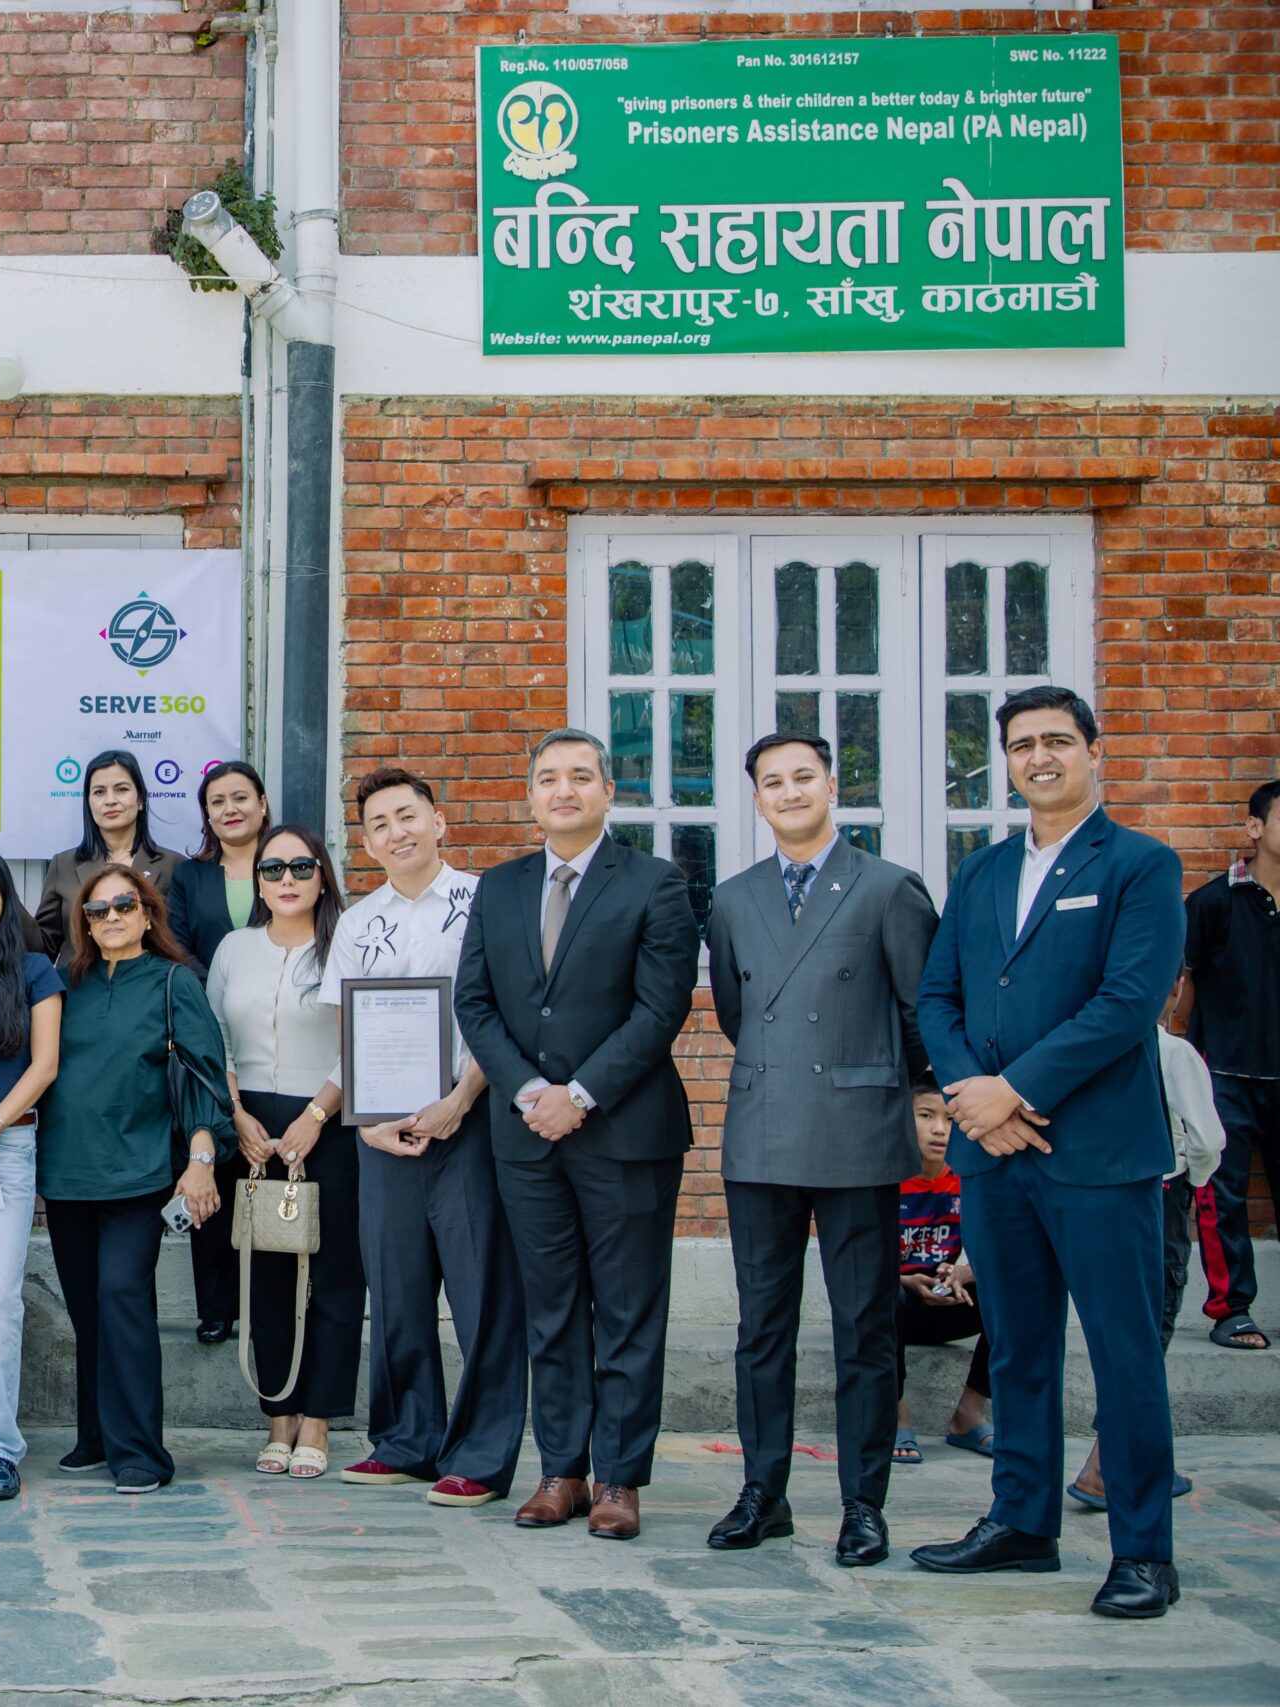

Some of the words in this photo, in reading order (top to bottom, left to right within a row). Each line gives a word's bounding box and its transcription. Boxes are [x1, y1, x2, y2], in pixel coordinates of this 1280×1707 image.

[736, 54, 761, 67] Pan
[765, 54, 786, 67] No.
[789, 53, 859, 66] 301612157
[1010, 49, 1038, 62] SWC
[1043, 49, 1064, 61] No.
[1068, 48, 1107, 60] 11222
[500, 60, 549, 74] Reg.No.
[552, 58, 629, 71] 110/057/058
[617, 97, 667, 115] "giving
[671, 96, 738, 113] prisoners
[742, 95, 753, 109] &
[757, 94, 792, 108] their
[796, 93, 854, 108] children
[858, 96, 867, 107] a
[871, 92, 916, 106] better
[919, 91, 960, 108] today
[964, 90, 976, 105] &
[980, 89, 1038, 107] brighter
[1041, 88, 1092, 103] future"
[628, 121, 740, 145] Prisoners
[746, 119, 879, 143] Assistance
[886, 116, 955, 145] Nepal
[963, 114, 1003, 144] (PA
[1010, 112, 1087, 142] Nepal)
[492, 182, 640, 275] बन्दि
[659, 201, 905, 275] सहायता
[925, 177, 1111, 266] नेपाल
[490, 332, 561, 345] Website:
[566, 332, 711, 346] www.panepal.org
[123, 729, 162, 740] Marriott
[148, 791, 187, 799] EMPOWER
